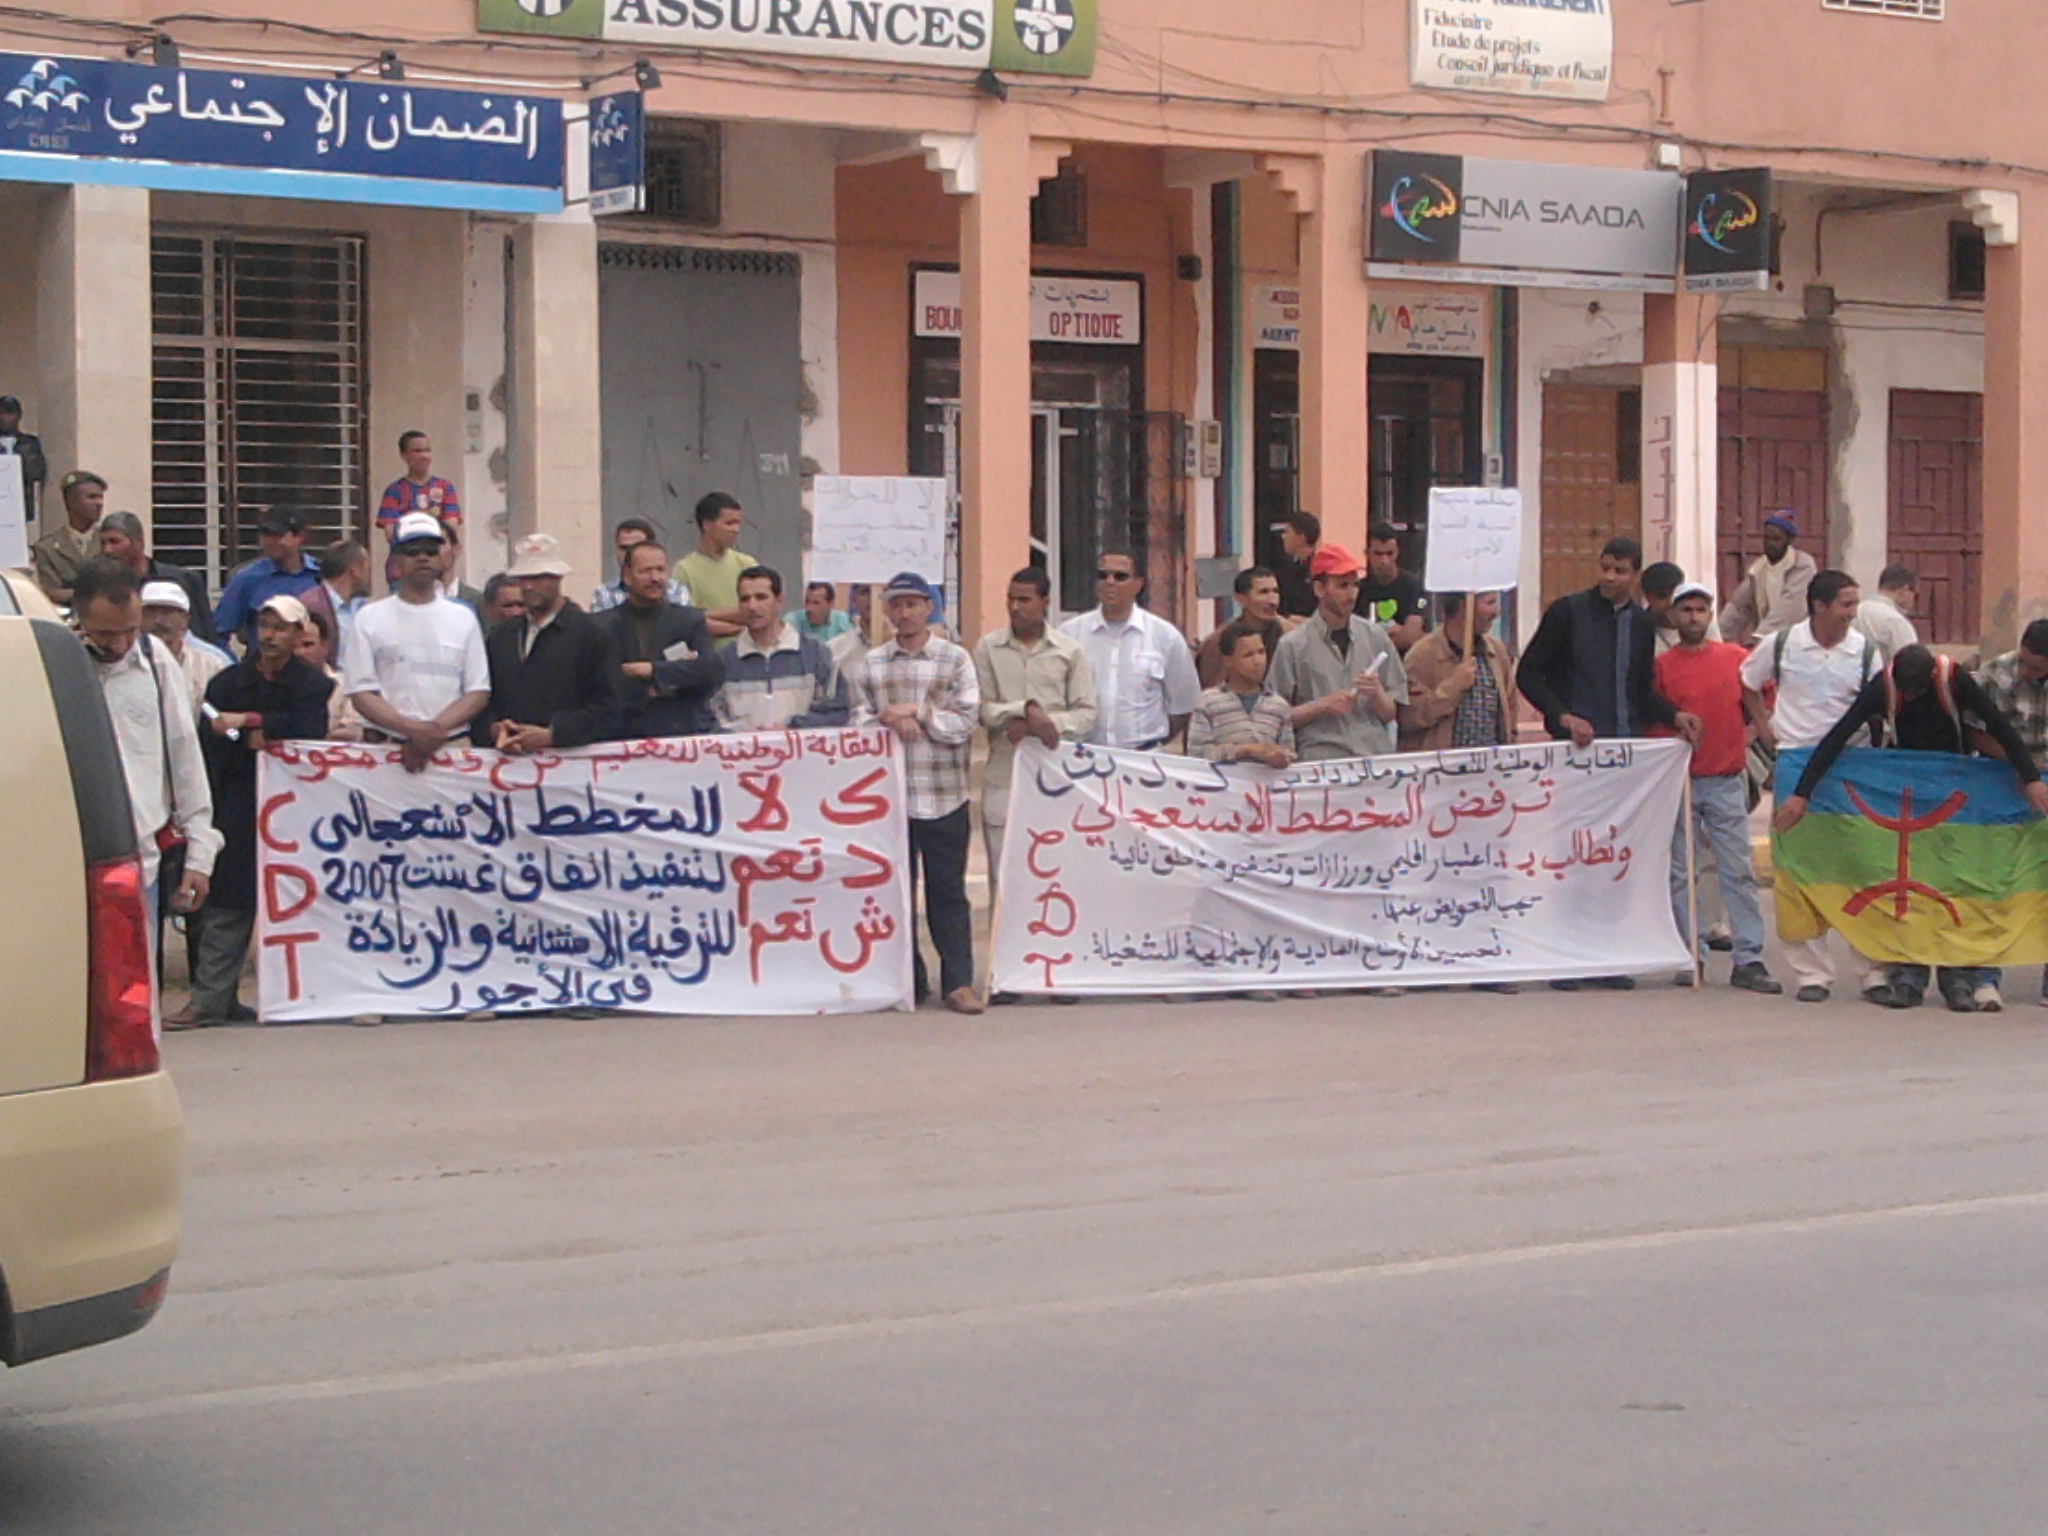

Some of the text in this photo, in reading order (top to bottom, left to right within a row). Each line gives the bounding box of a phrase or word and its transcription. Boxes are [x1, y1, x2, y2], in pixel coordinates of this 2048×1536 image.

[609, 0, 986, 51] ASSURANCES
[1432, 29, 1541, 56] Etude de projets
[1437, 52, 1489, 73] Conseil
[1492, 56, 1555, 79] juridique
[365, 91, 540, 160] الضمان
[1461, 194, 1531, 222] CNIA
[1539, 199, 1645, 230] SAADA
[1050, 312, 1123, 338] OPTIQUE
[703, 730, 801, 771] الوطنية
[806, 729, 892, 766] النقابة
[1492, 745, 1554, 783] الوطنية
[1565, 742, 1633, 776] النقابة
[1421, 749, 1489, 792] للتعليم
[1276, 782, 1423, 835] المخطط
[1428, 778, 1555, 839] ترفض
[1541, 823, 1633, 882] ونطالب
[322, 853, 407, 905] 2007
[620, 848, 727, 900] لتنفيذ
